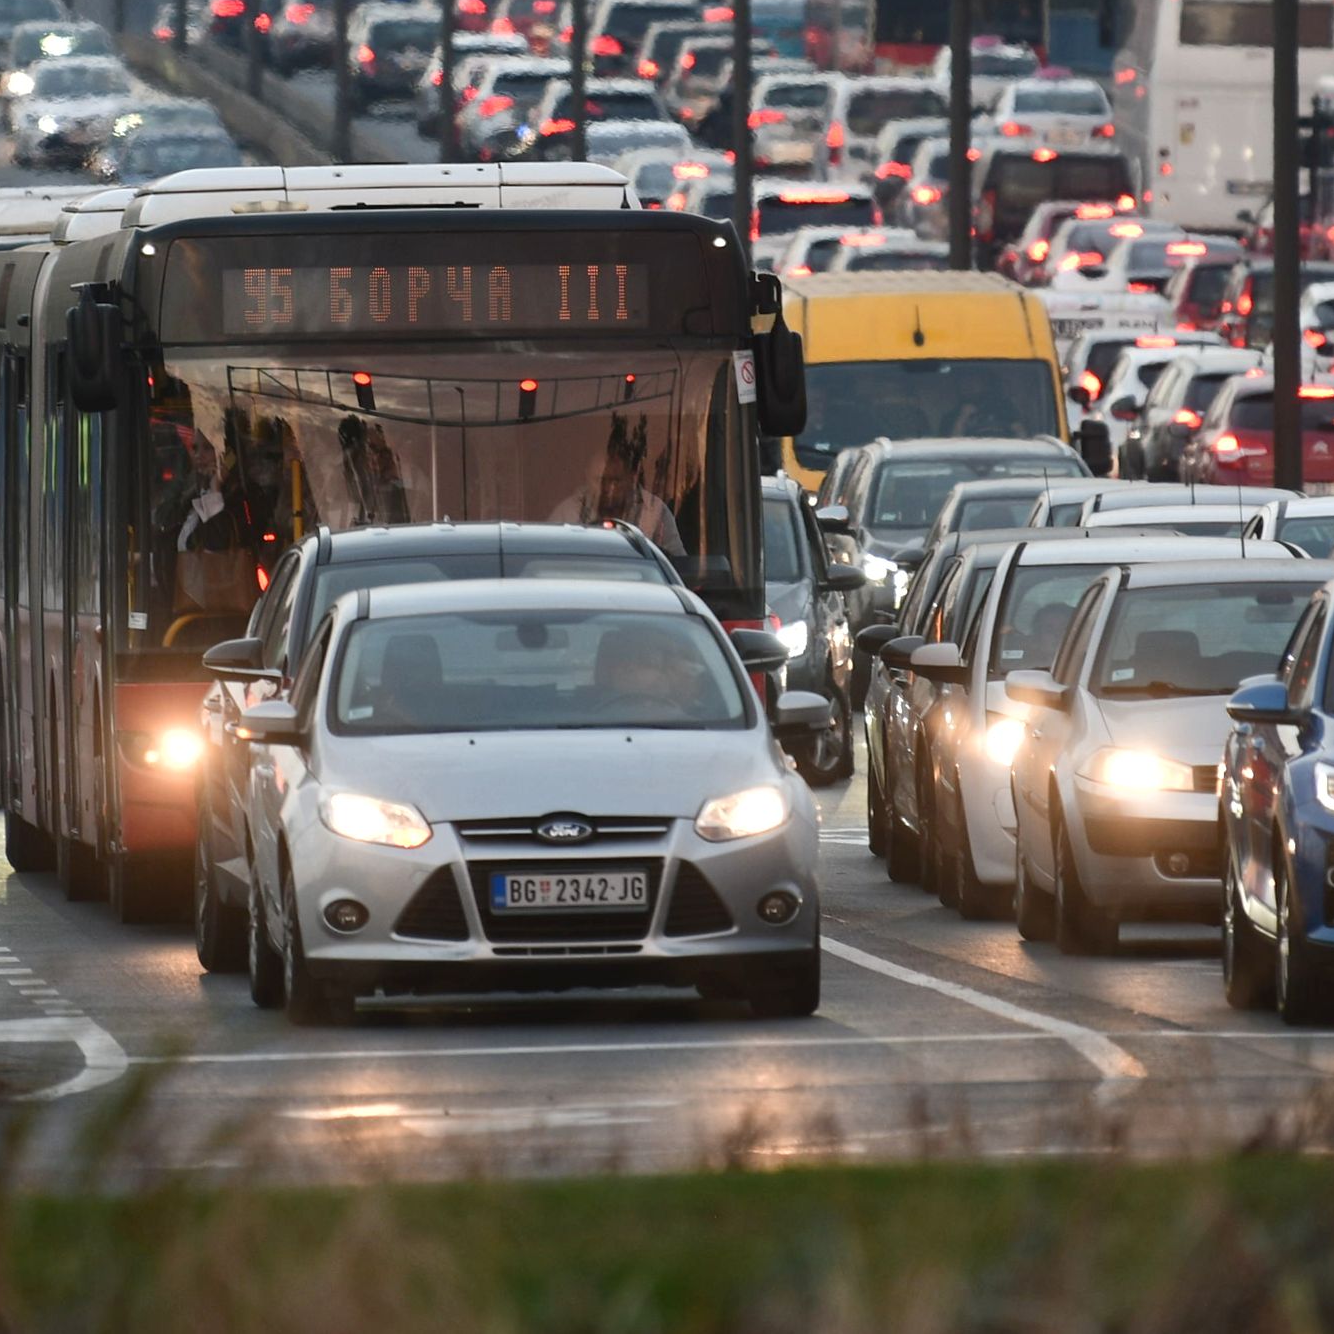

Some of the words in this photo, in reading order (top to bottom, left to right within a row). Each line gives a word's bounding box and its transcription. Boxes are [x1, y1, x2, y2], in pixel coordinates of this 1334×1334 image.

[244, 268, 293, 324] 95
[330, 266, 512, 323] БОРЧА
[510, 879, 537, 904] BG
